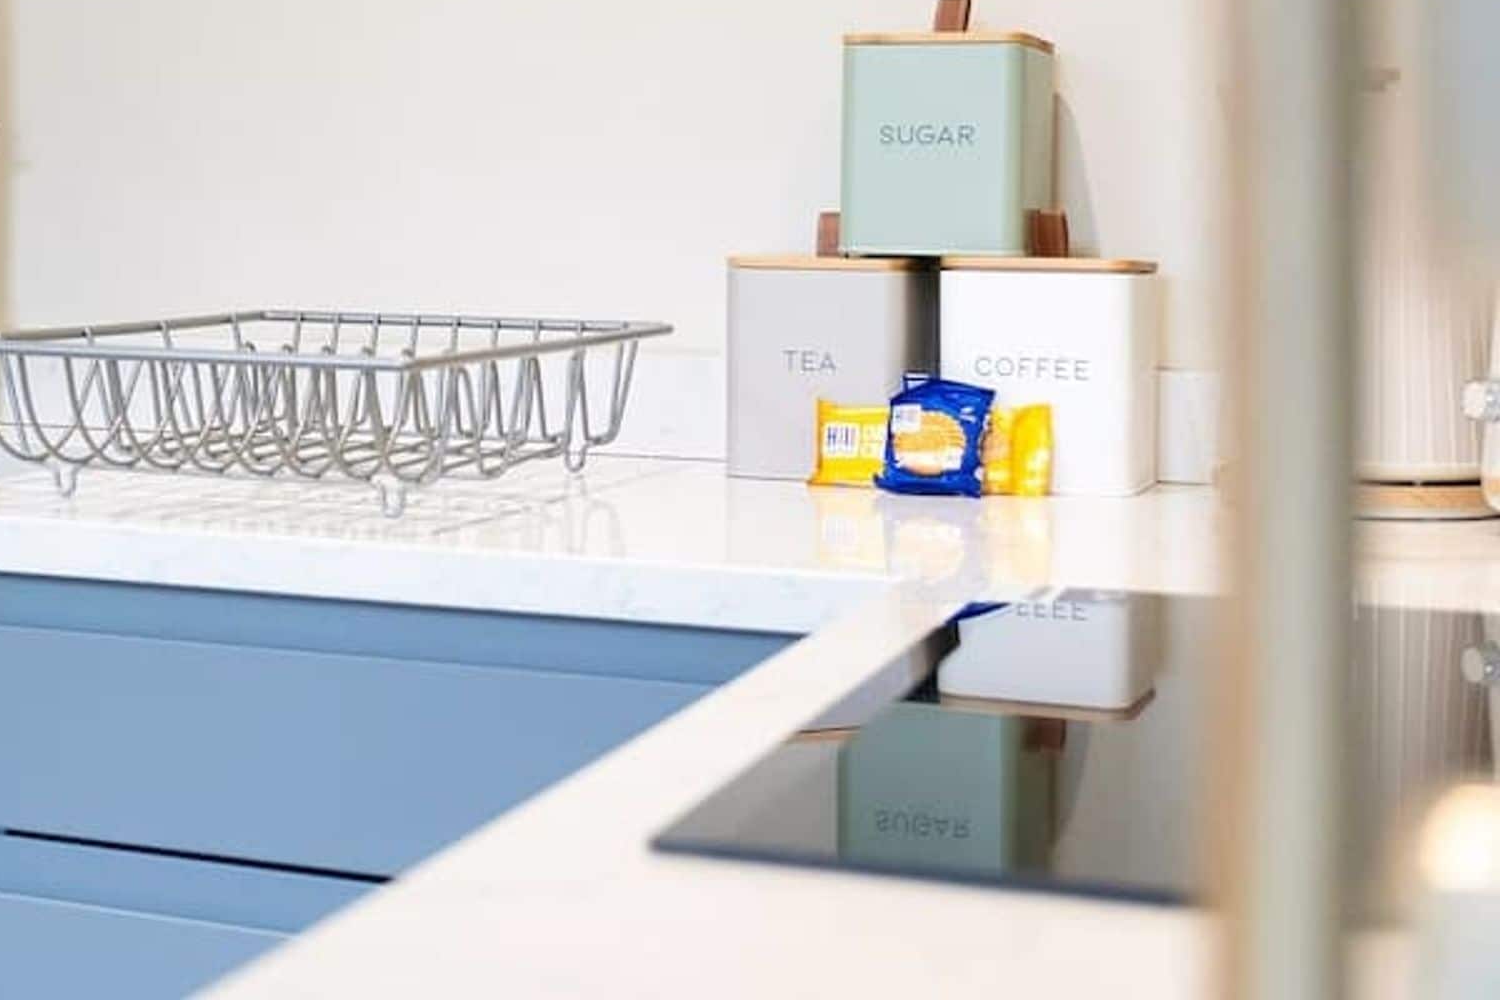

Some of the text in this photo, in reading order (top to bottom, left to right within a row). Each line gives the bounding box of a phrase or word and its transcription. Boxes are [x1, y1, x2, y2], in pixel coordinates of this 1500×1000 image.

[879, 124, 977, 146] SUGAR
[782, 349, 837, 373] TEA
[975, 356, 1092, 382] COFFEE
